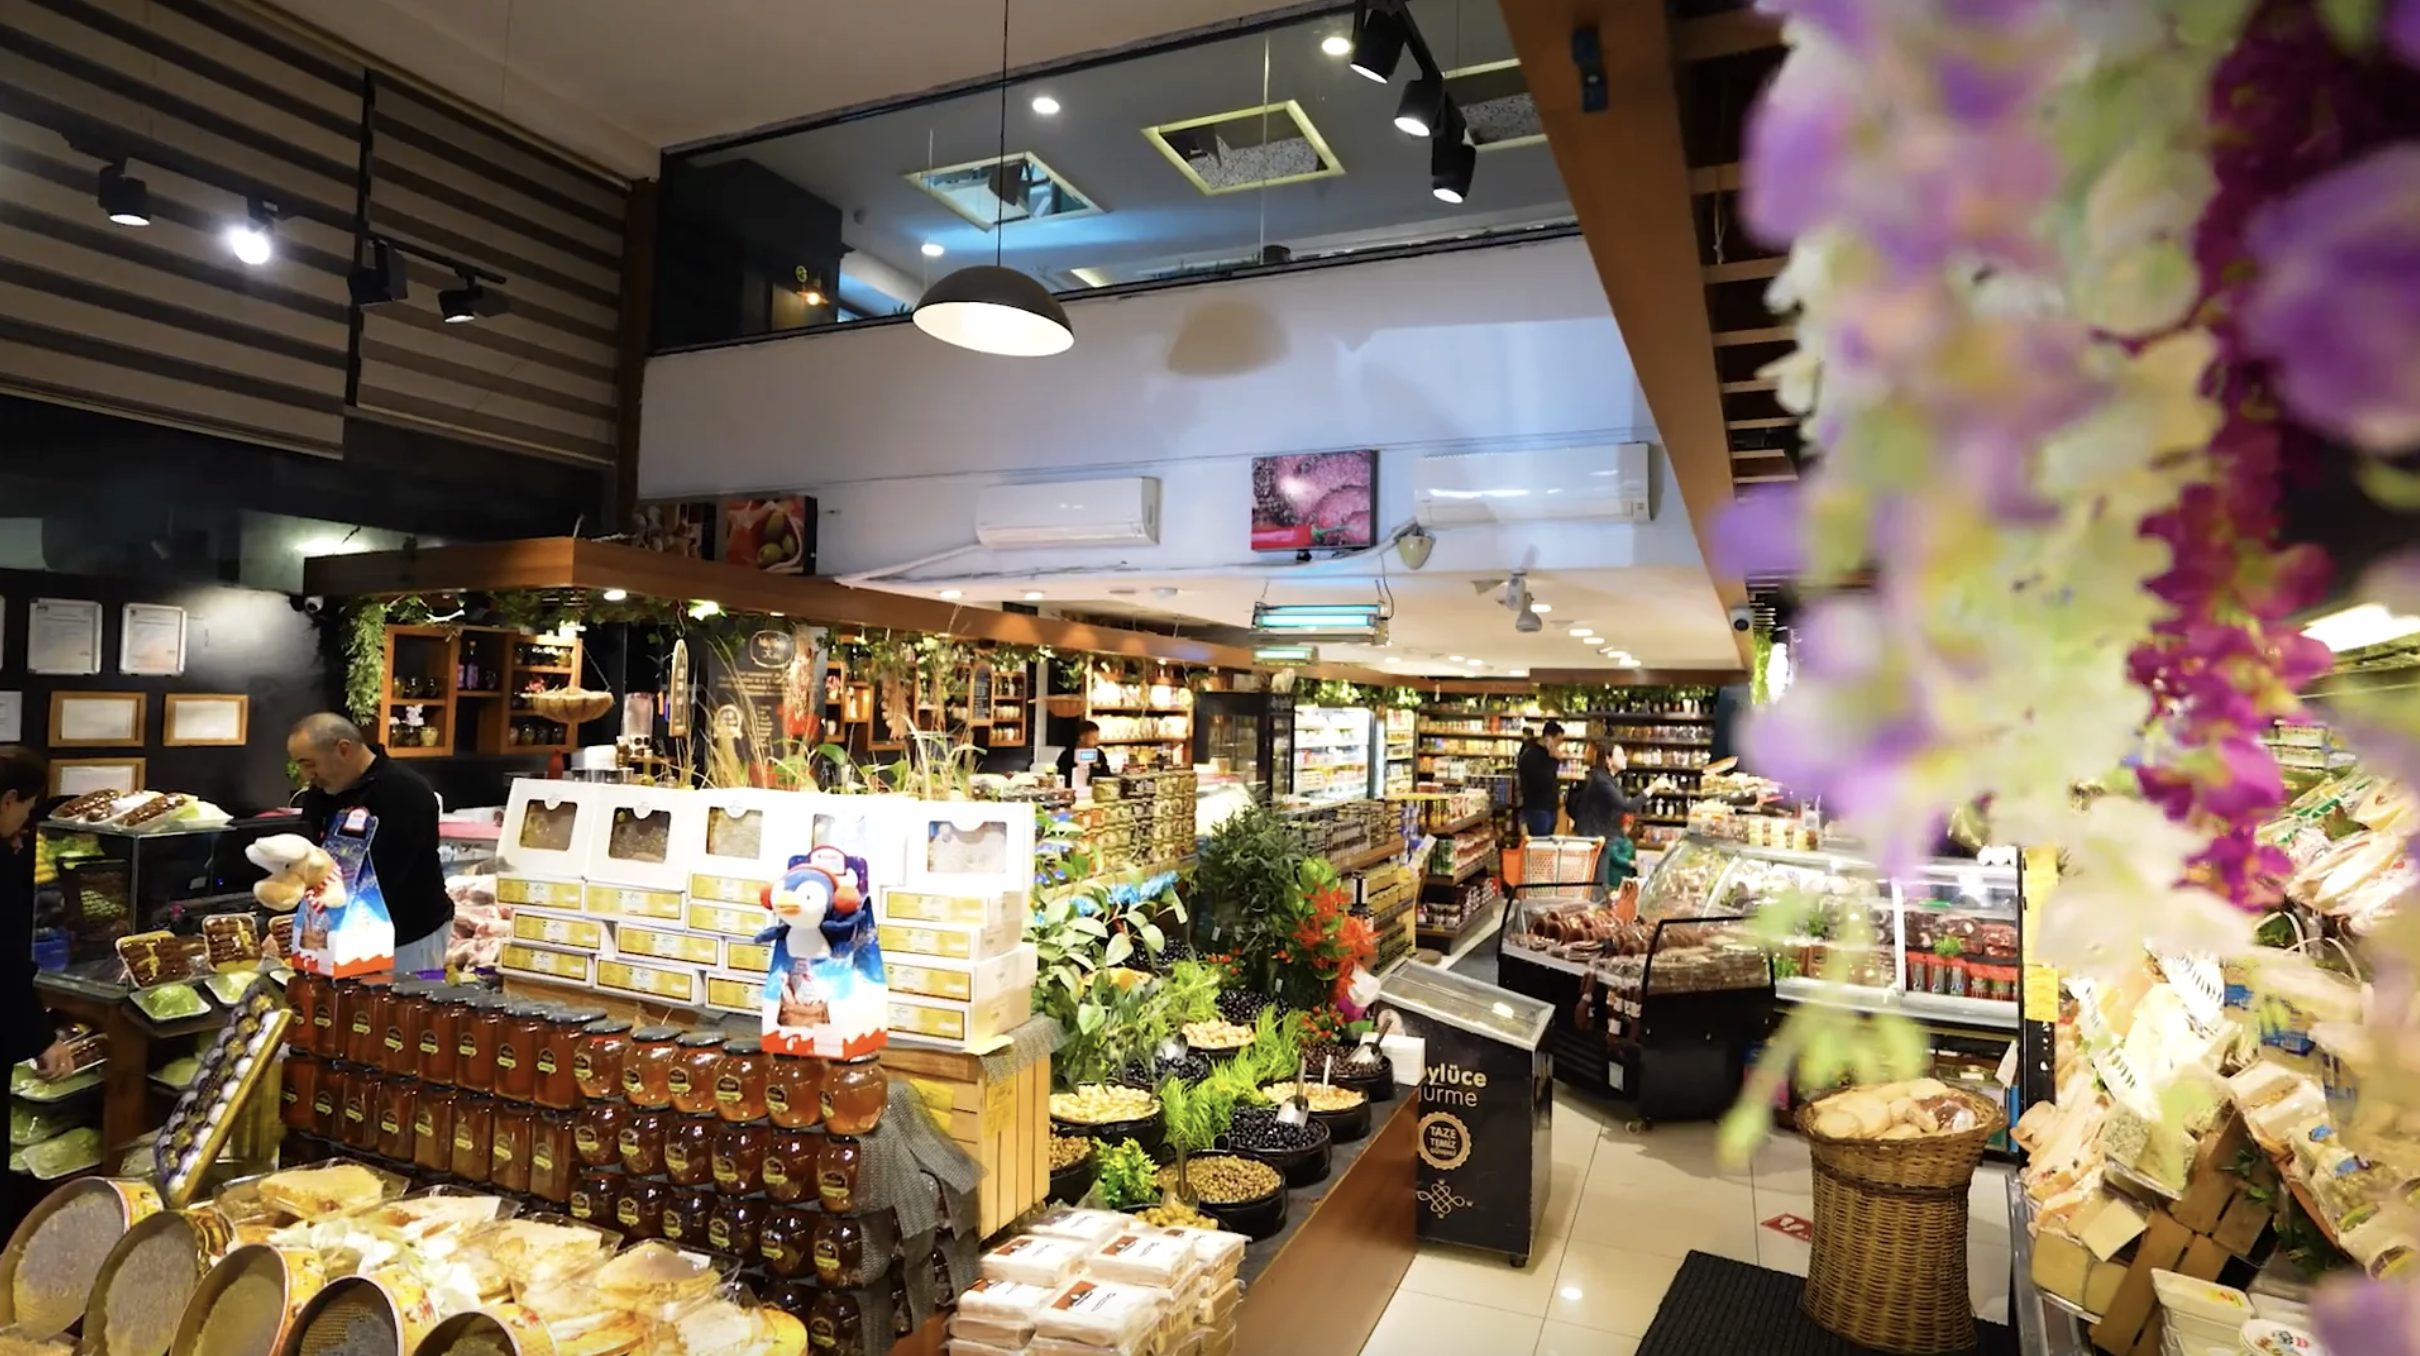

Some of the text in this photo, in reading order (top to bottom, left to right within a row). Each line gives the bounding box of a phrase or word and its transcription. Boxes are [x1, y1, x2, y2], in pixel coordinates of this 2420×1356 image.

[1425, 1063, 1487, 1087] ylüce
[1418, 1085, 1478, 1108] urme
[1430, 1126, 1457, 1139] TAZE
